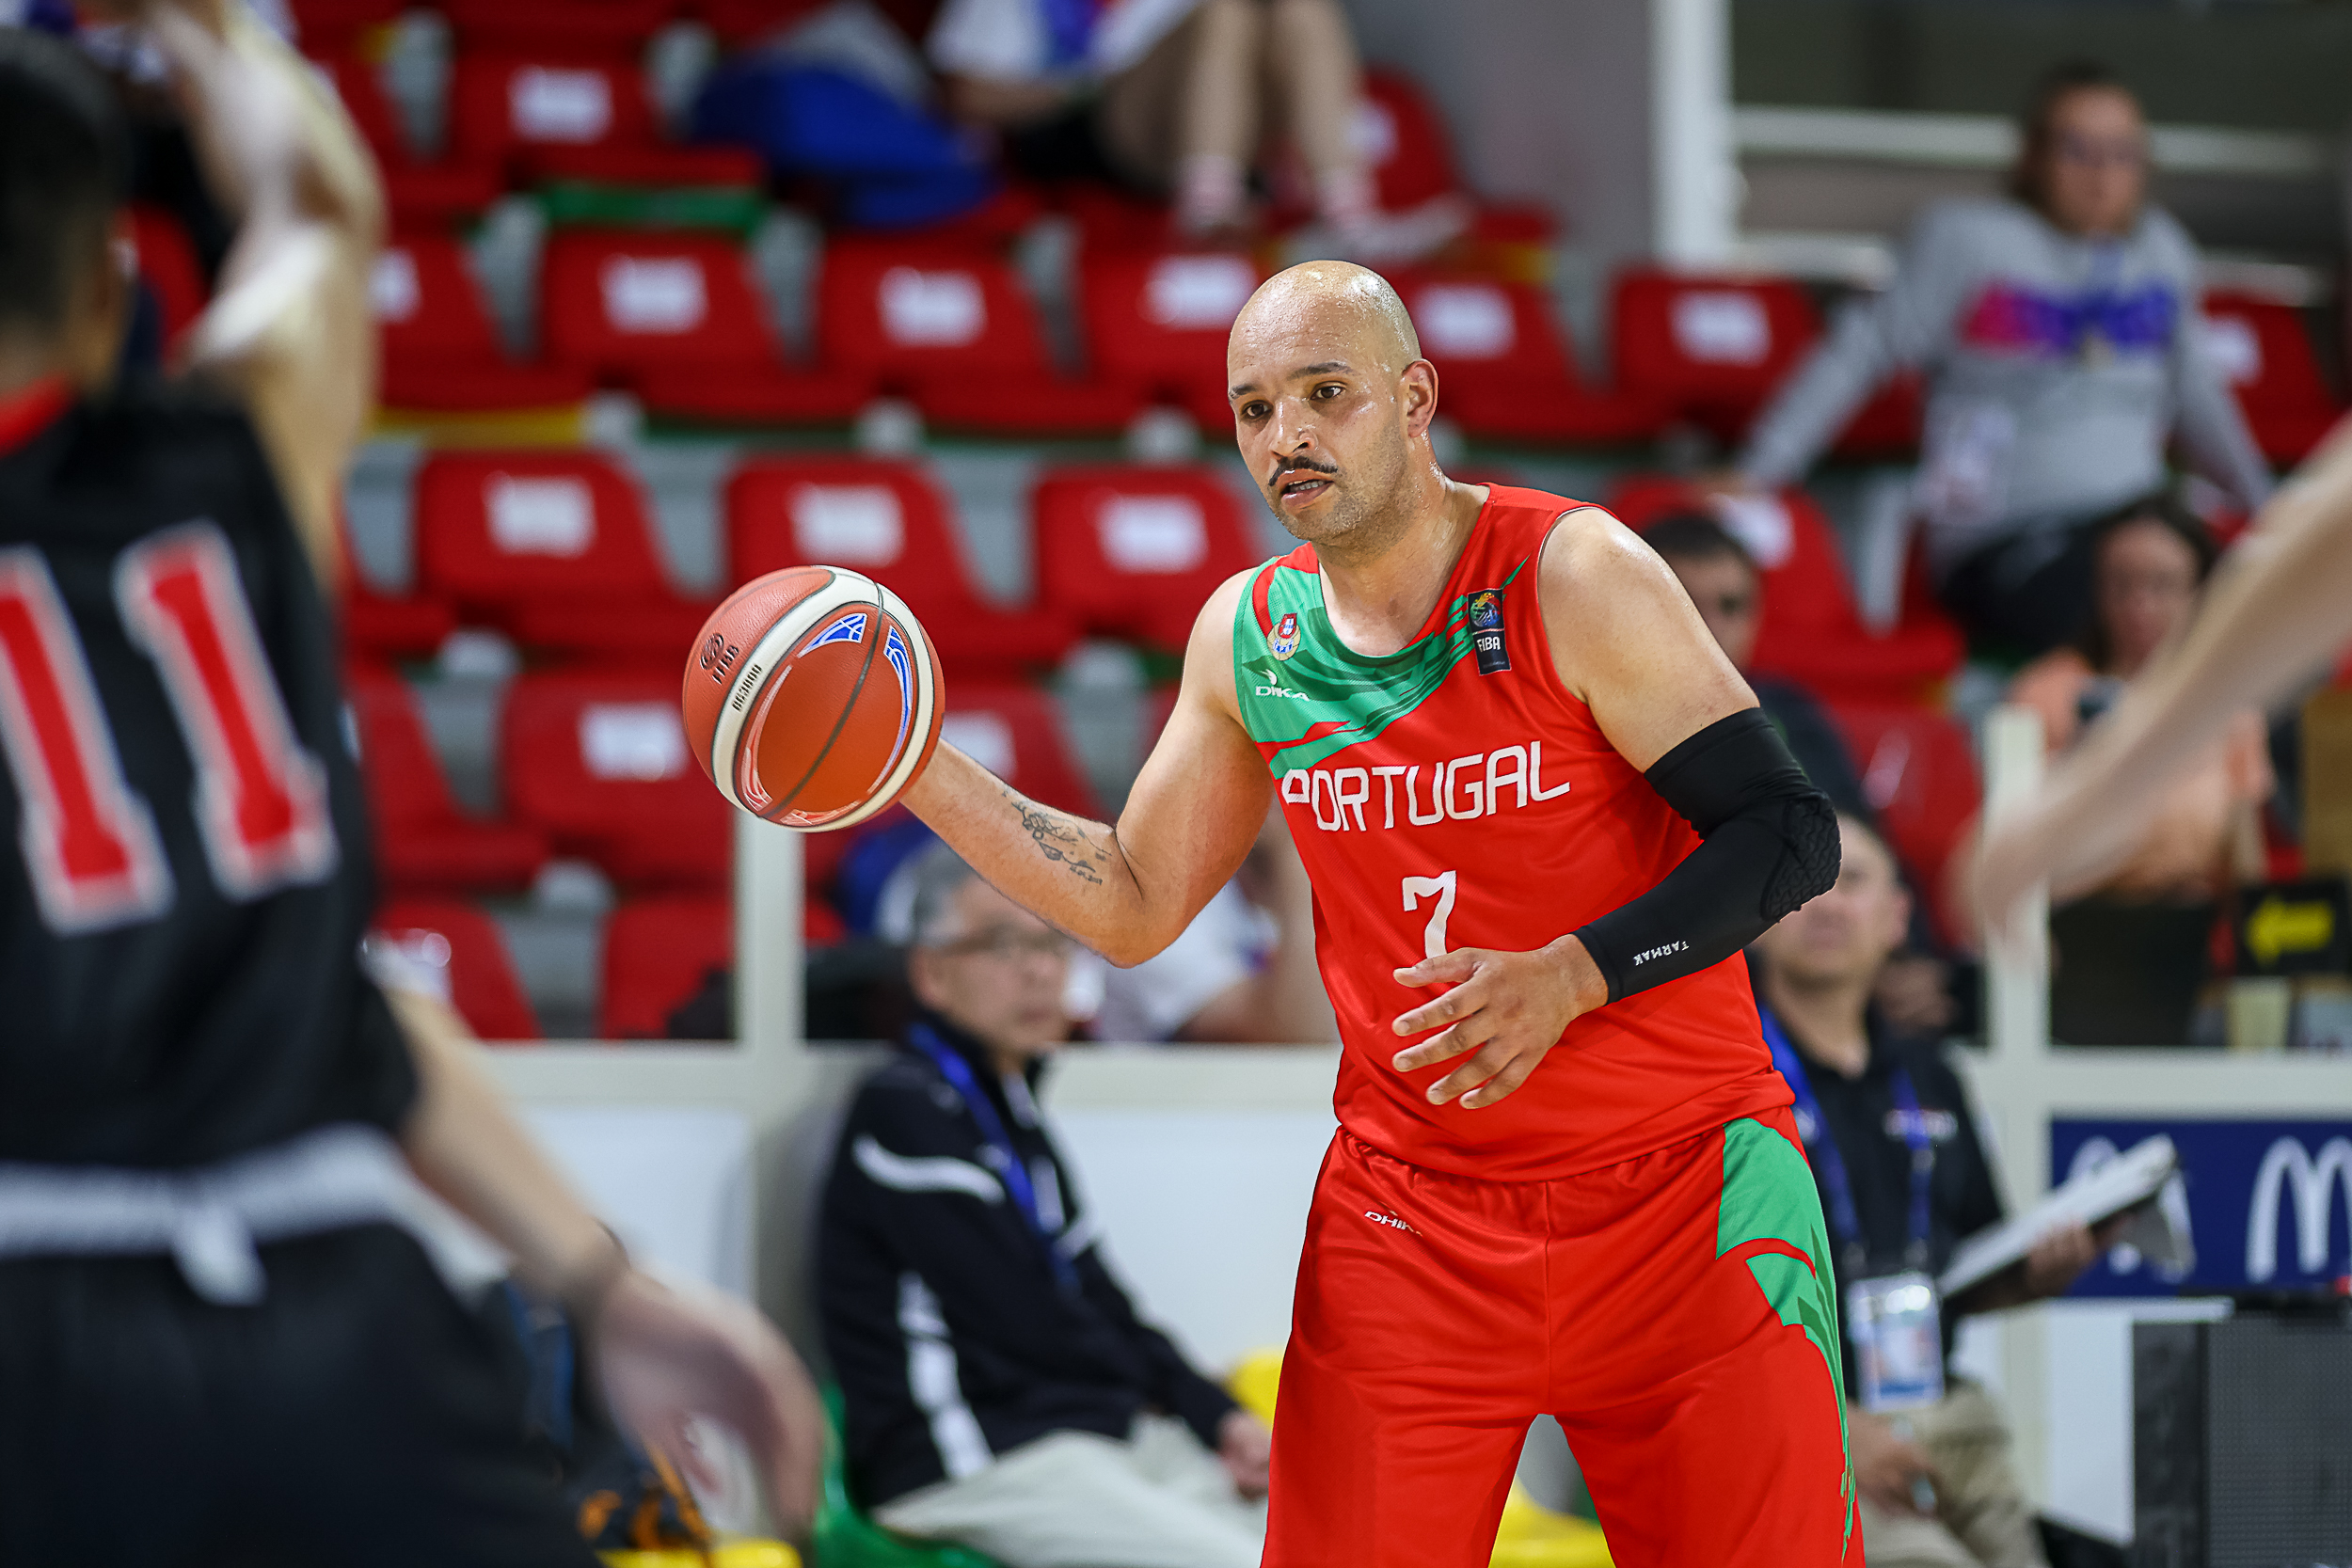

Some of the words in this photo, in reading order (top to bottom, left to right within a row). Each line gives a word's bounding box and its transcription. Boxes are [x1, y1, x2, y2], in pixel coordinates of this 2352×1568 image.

[1476, 636, 1501, 653] FIBA
[0, 517, 340, 933] 11
[1281, 740, 1570, 832] PORTUGAL
[1401, 870, 1457, 959] 7
[1633, 941, 1690, 966] TARMAK
